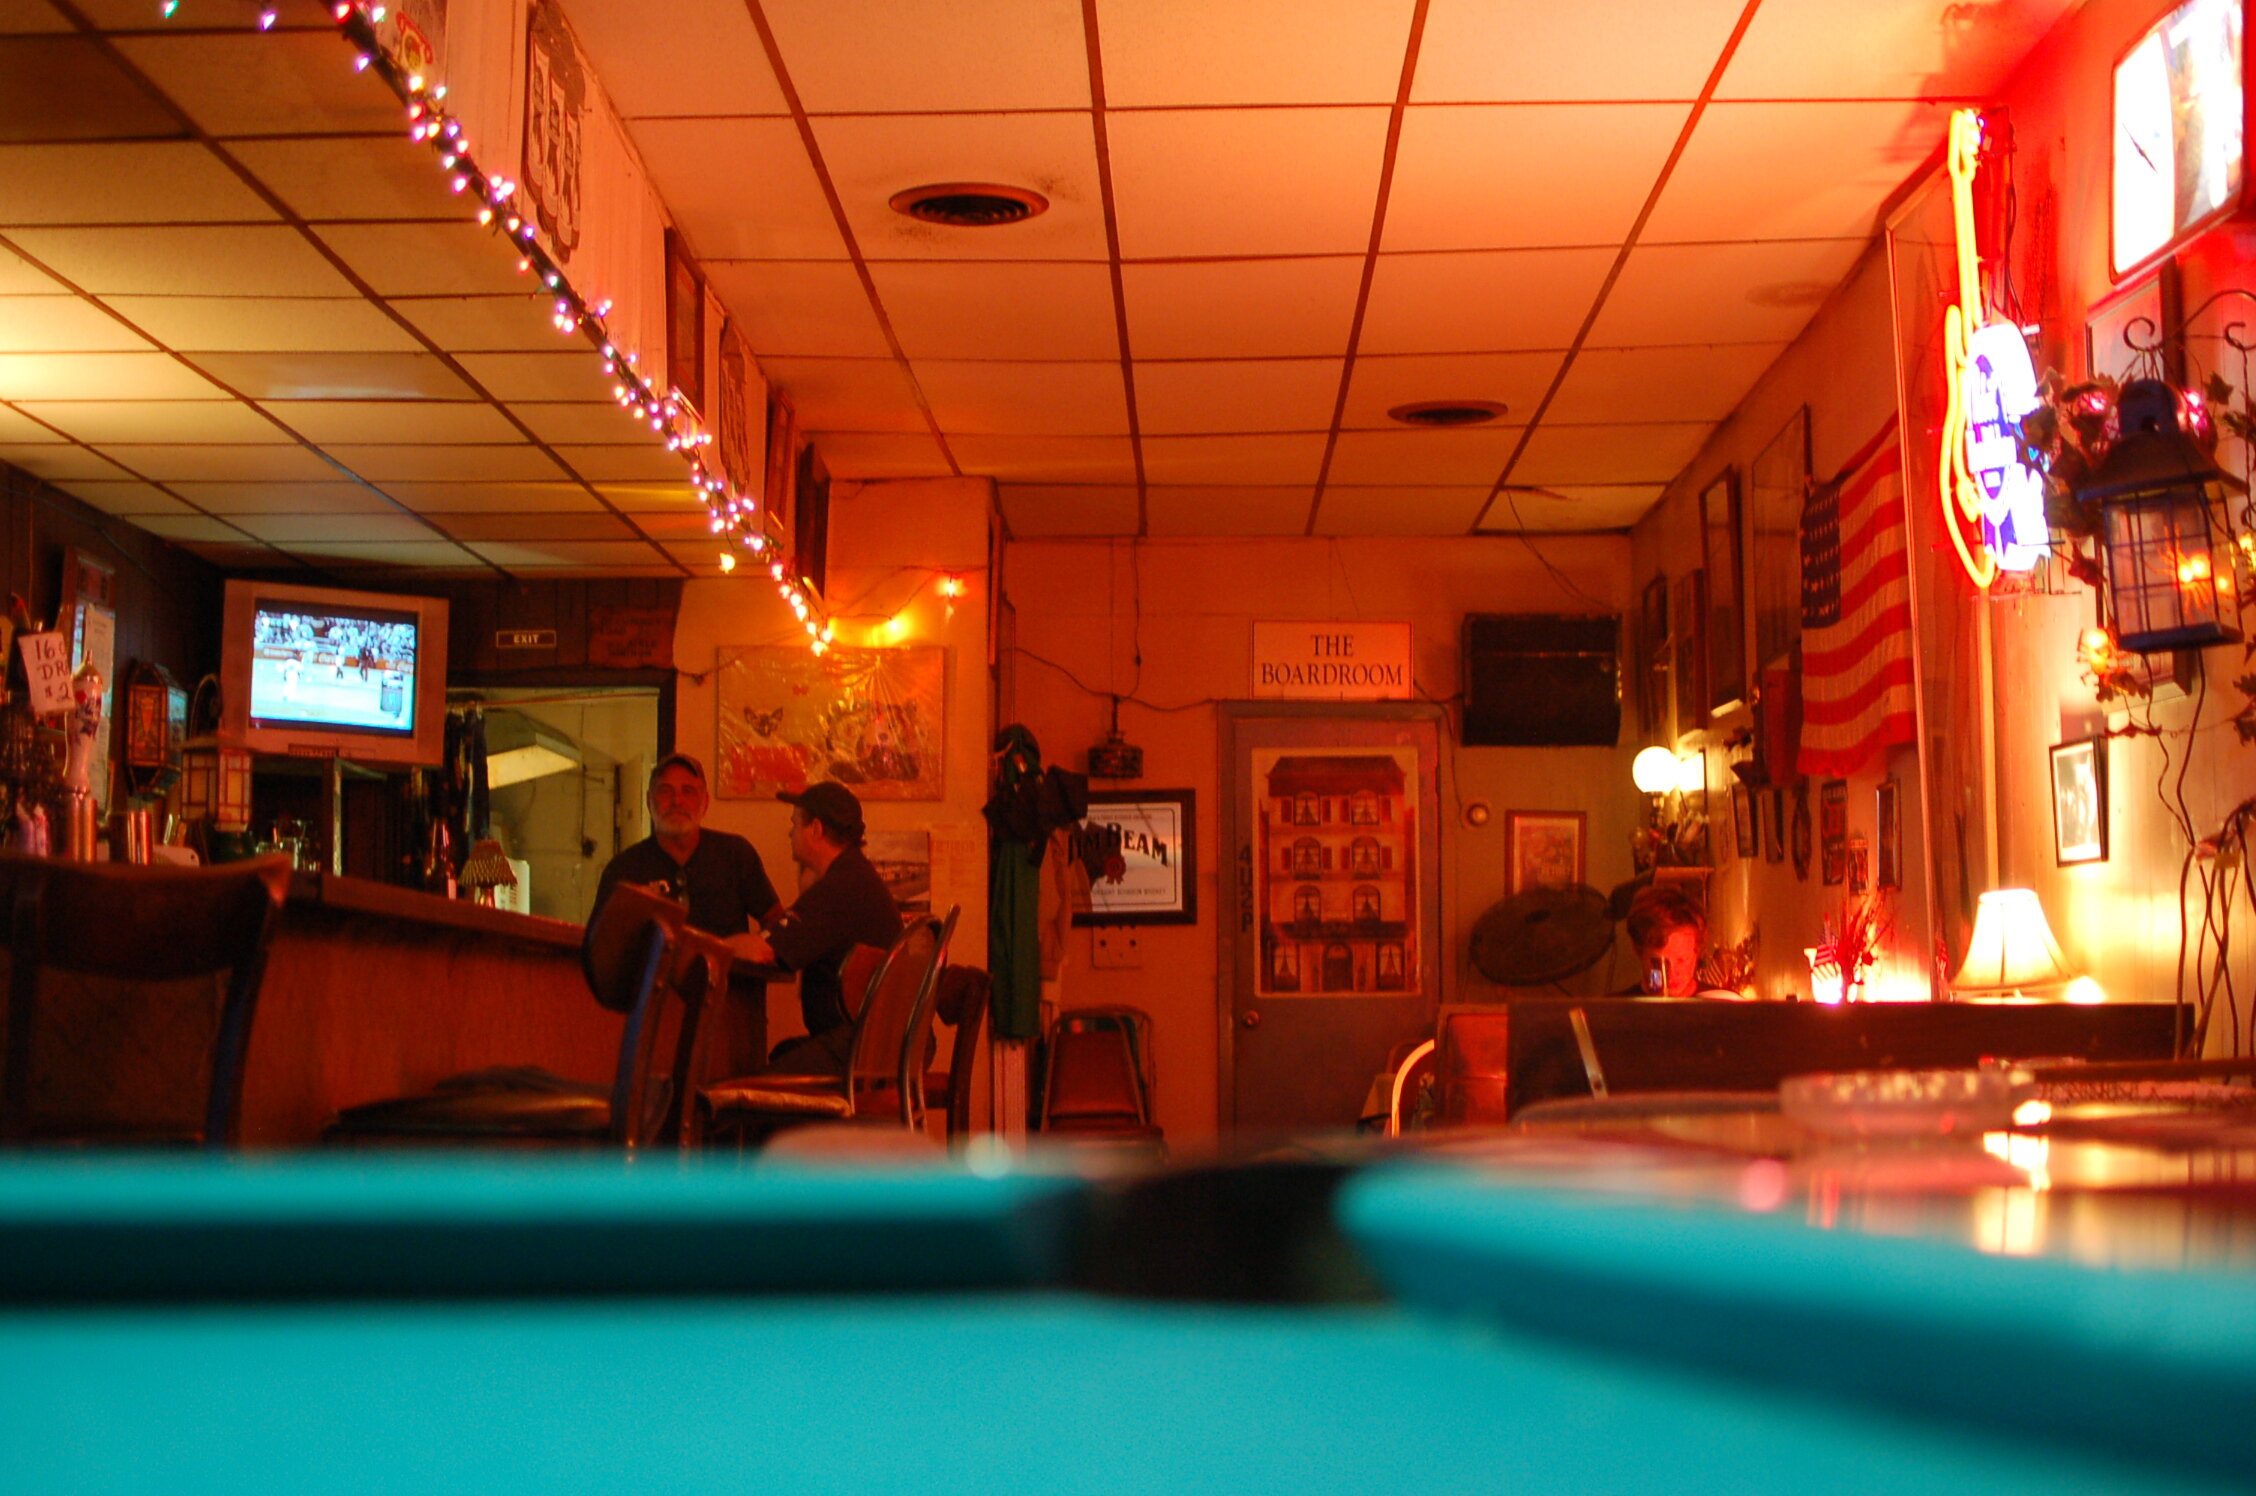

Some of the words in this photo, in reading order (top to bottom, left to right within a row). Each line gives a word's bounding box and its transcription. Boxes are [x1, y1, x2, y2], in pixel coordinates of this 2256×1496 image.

[513, 633, 540, 645] EXIT
[1311, 635, 1354, 657] THE
[1262, 663, 1402, 686] BOARDROOM
[1106, 822, 1168, 867] BEAM
